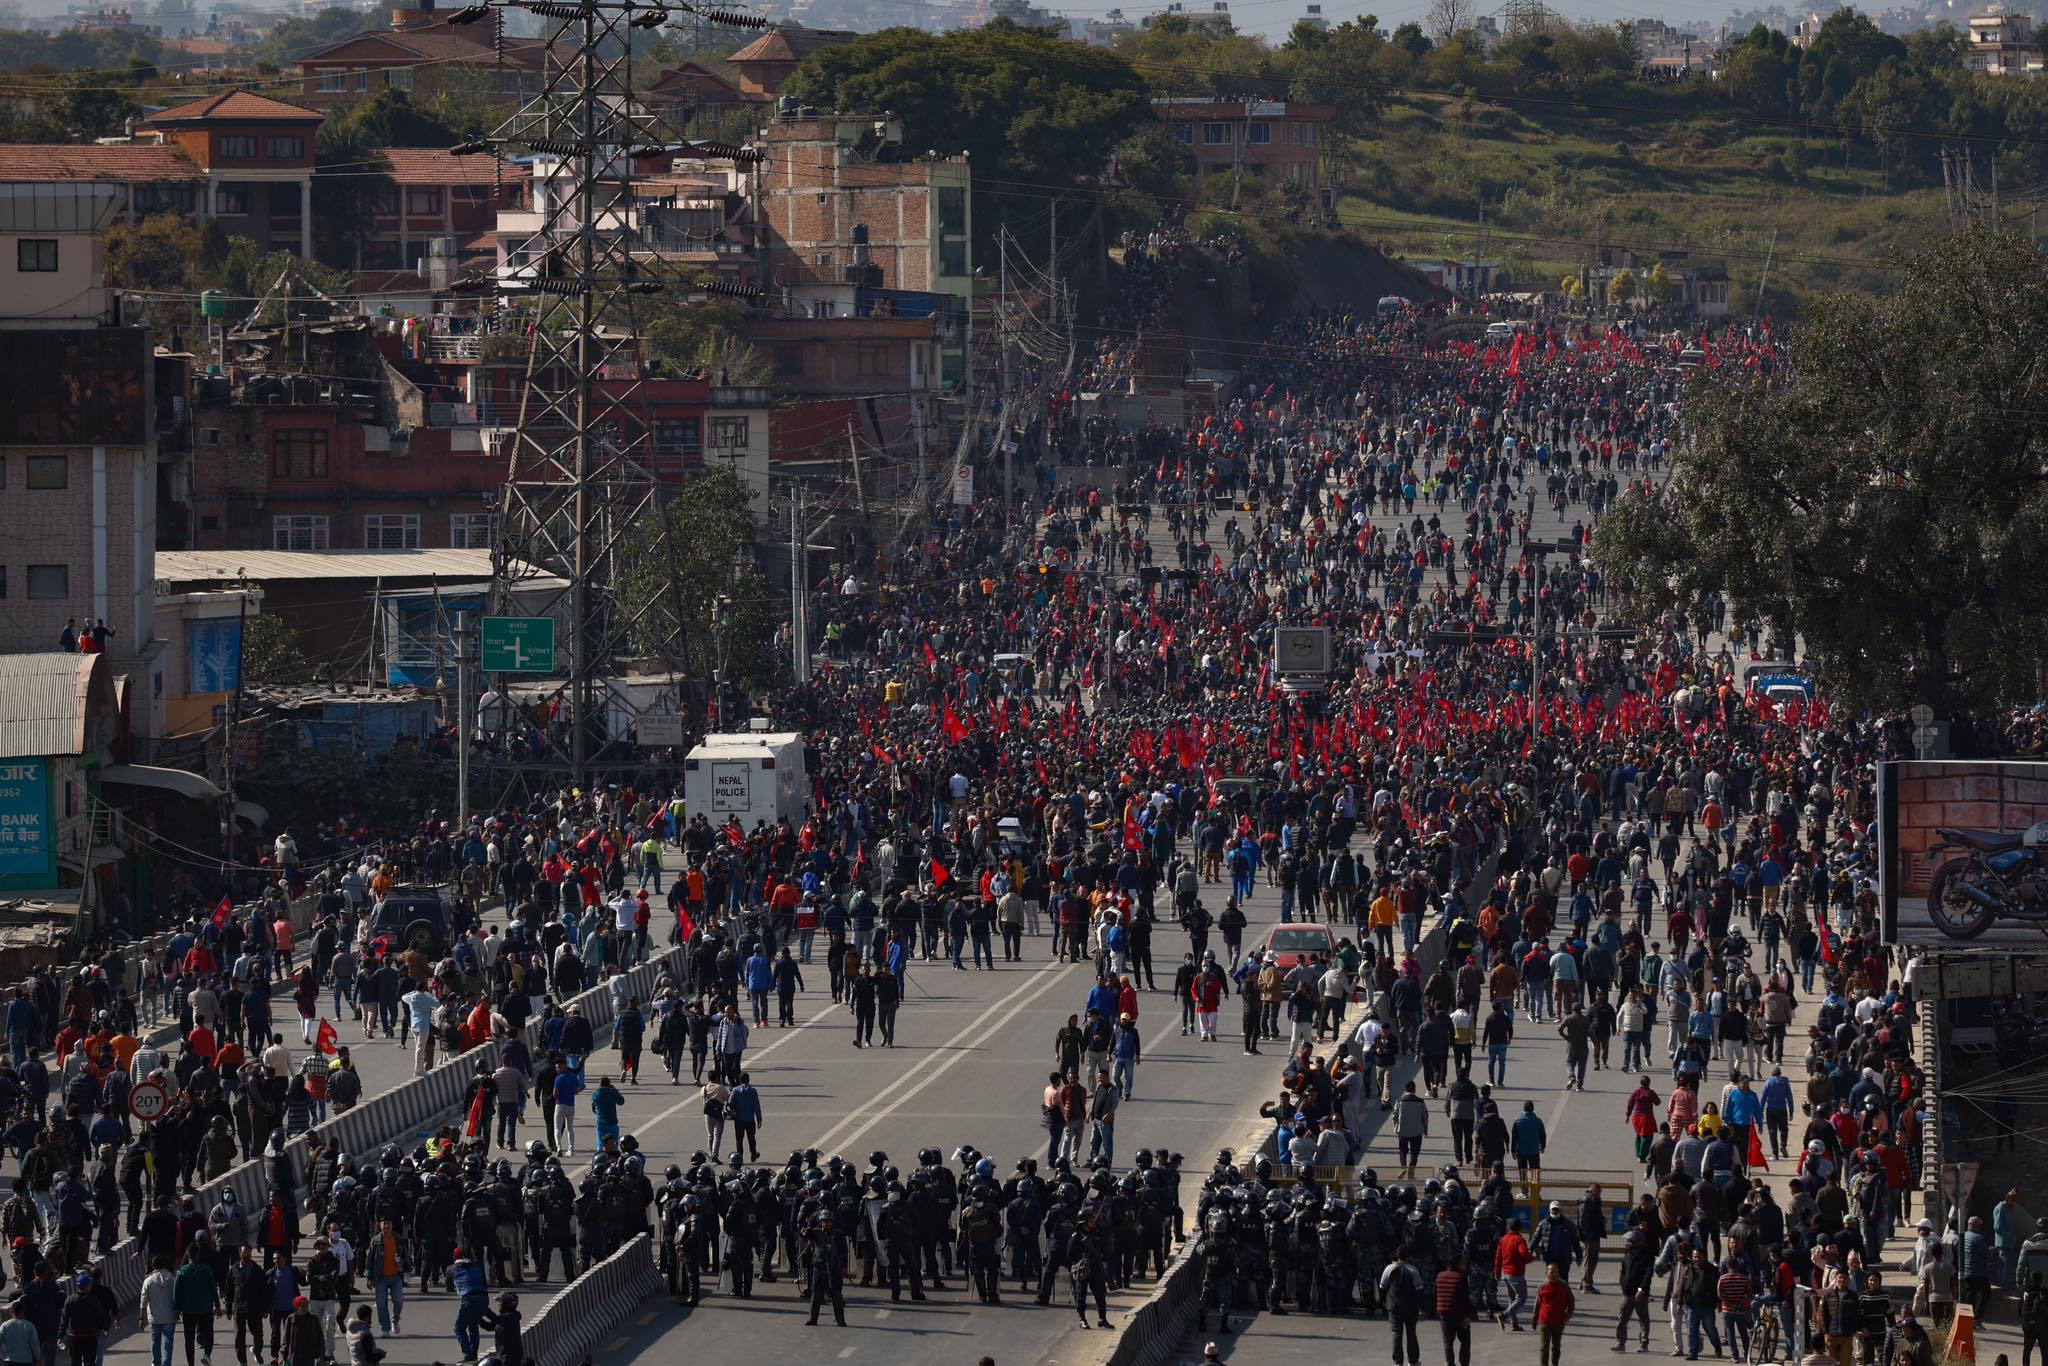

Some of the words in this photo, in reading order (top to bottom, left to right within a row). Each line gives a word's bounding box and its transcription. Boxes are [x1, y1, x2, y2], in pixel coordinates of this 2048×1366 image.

[719, 776, 743, 785] NEPAL
[715, 788, 746, 797] POLICE
[2, 814, 39, 825] BANK
[135, 1095, 161, 1107] 20T
